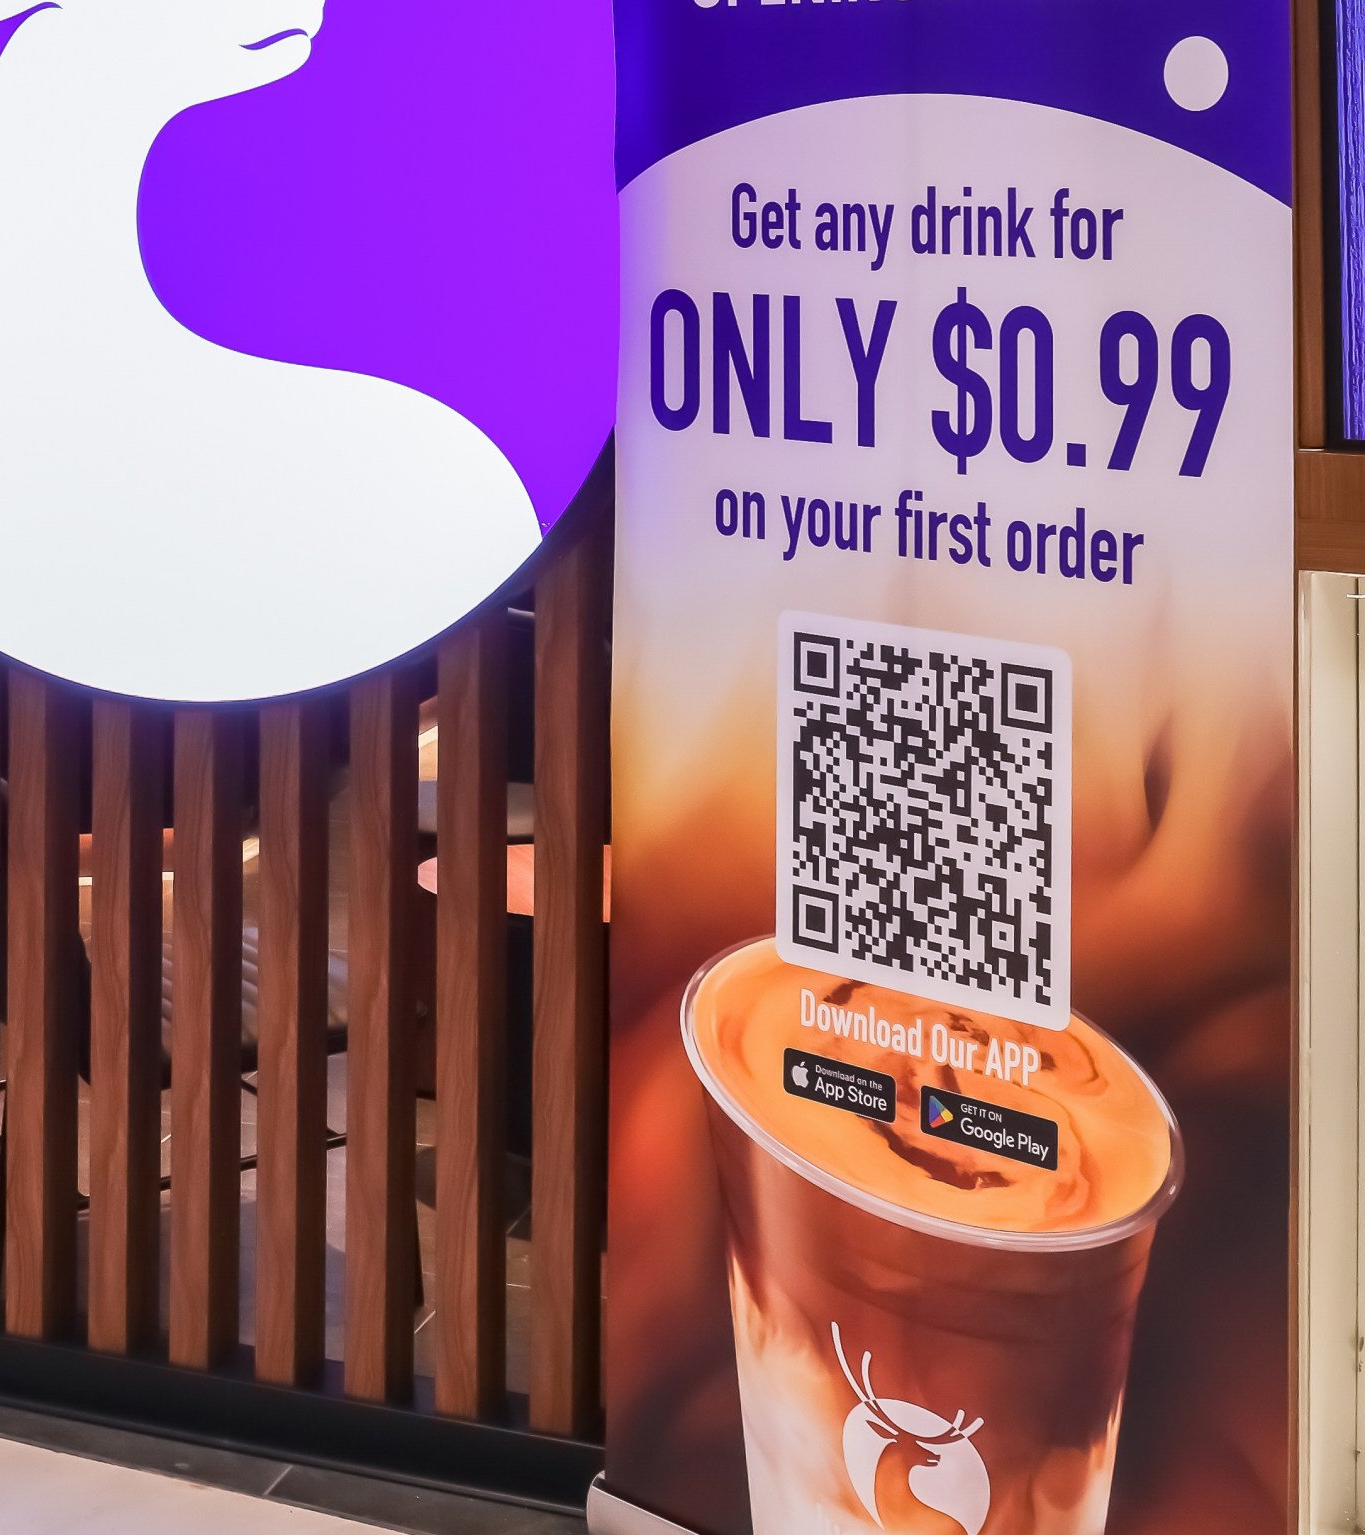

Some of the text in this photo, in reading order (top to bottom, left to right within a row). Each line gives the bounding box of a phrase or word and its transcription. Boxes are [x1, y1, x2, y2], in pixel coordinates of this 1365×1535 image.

[732, 183, 1123, 271] Get any drink for
[651, 287, 1230, 477] ONLY $0.99
[716, 489, 1144, 584] on your first order
[799, 988, 1040, 1087] Download Our APP
[814, 1077, 887, 1112] App Store
[815, 1064, 883, 1092] Download on the
[960, 1103, 1003, 1124] GET IT ON
[960, 1117, 1050, 1162] Google Play
